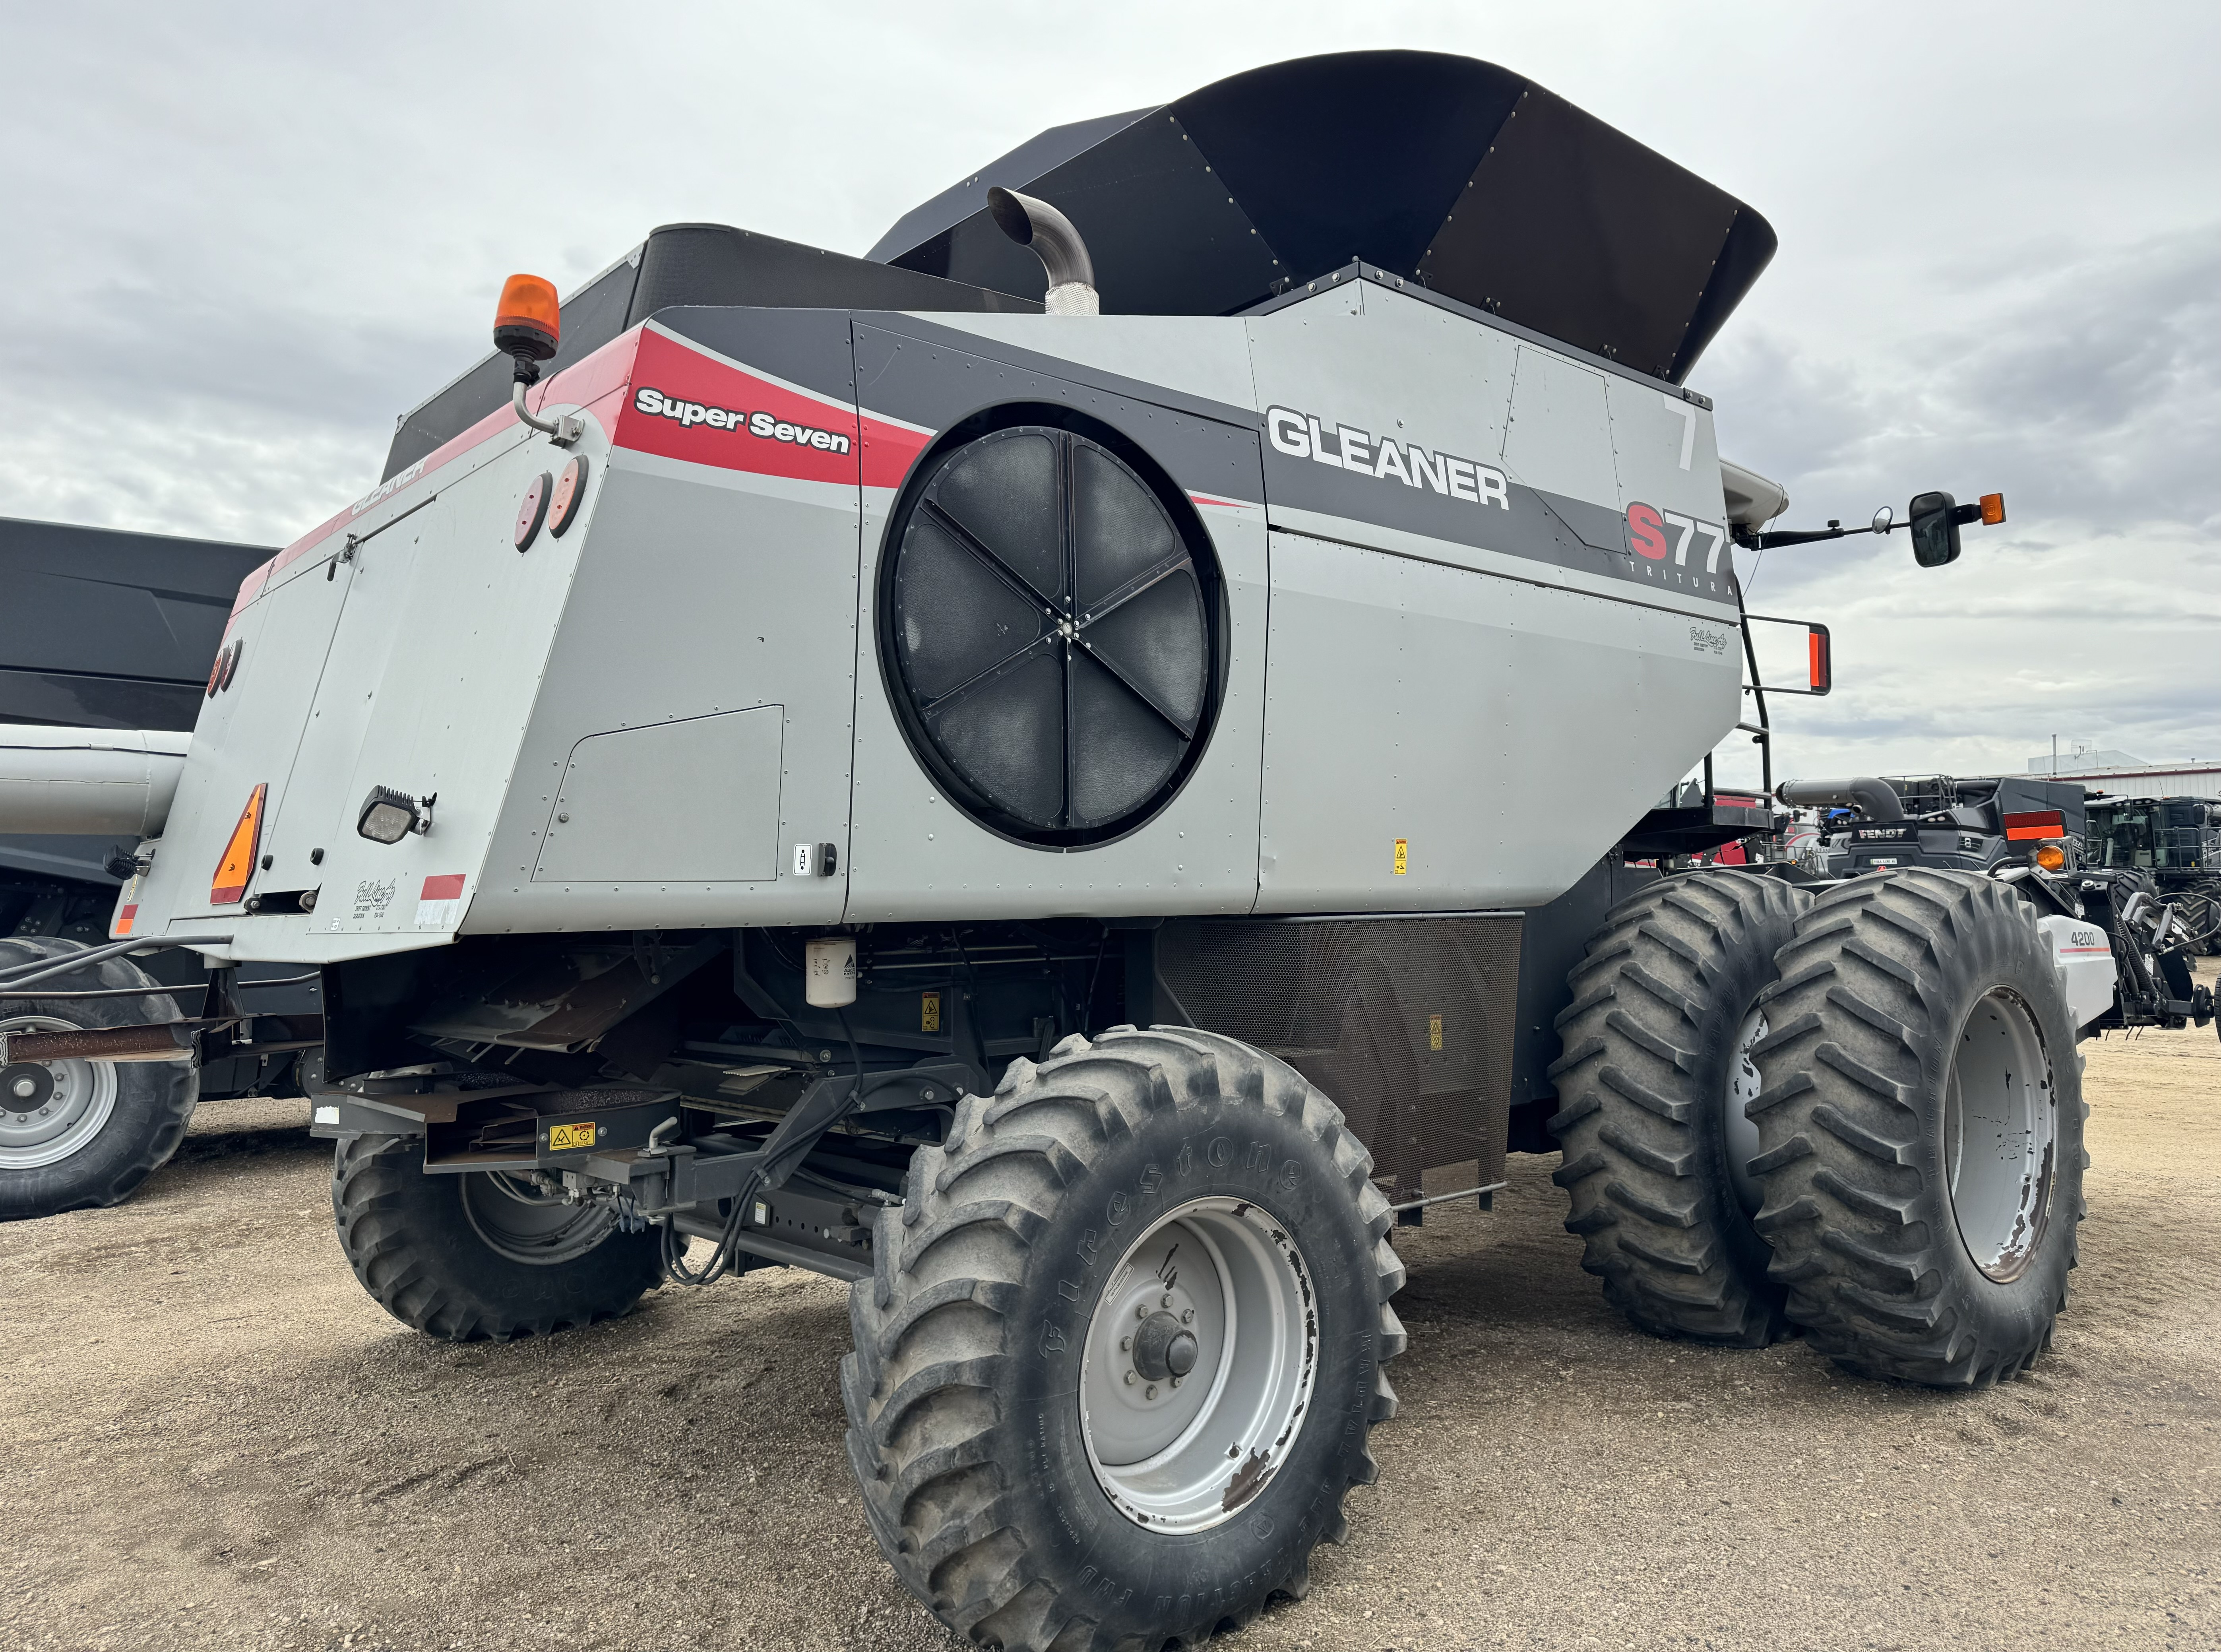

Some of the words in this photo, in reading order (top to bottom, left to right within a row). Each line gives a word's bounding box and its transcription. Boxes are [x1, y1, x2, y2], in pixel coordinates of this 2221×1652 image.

[636, 388, 744, 430] Super
[750, 412, 850, 454] Seven
[1663, 394, 1696, 471] 7
[1267, 405, 1510, 510] GLEANER
[1628, 504, 1725, 574] S77
[1630, 560, 1733, 596] TRITURA
[1859, 828, 1907, 839] FENDT
[2071, 931, 2095, 946] 4200
[1037, 1136, 1305, 1360] Firestone
